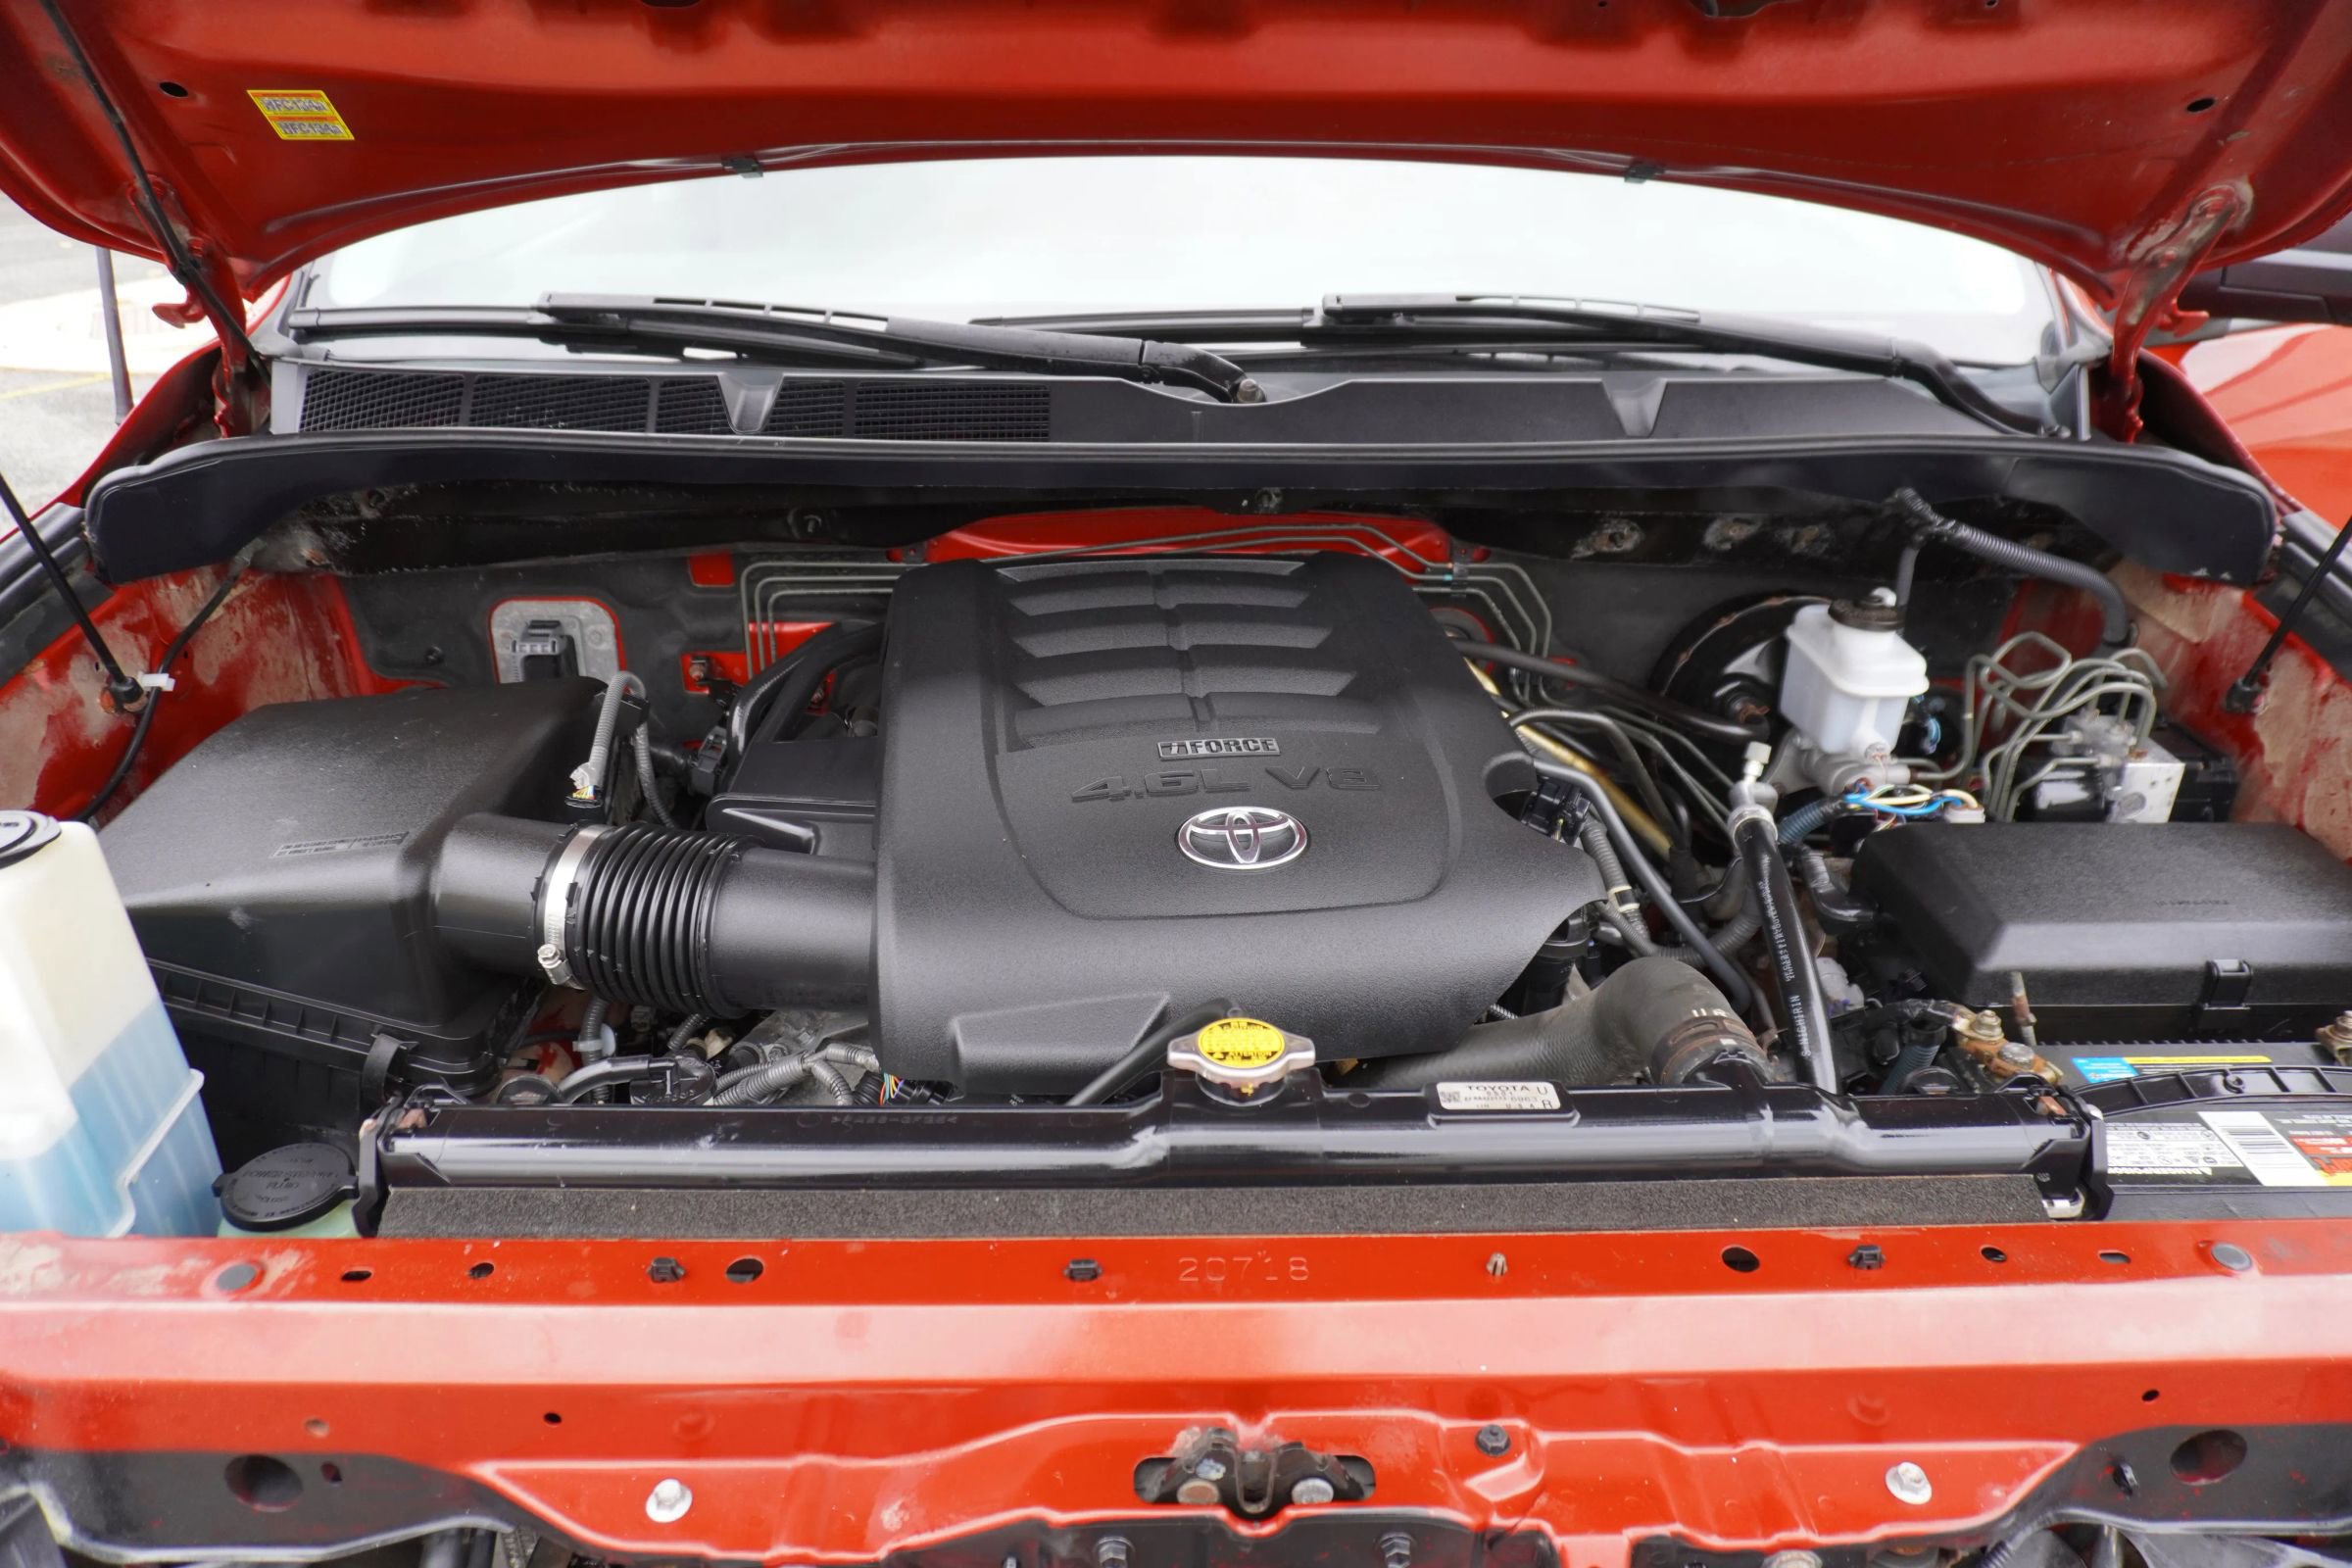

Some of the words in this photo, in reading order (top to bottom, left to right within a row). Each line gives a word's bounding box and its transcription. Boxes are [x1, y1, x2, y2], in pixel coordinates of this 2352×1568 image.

[1071, 767, 1251, 803] 4.6L
[1264, 765, 1381, 791] V8
[1178, 1256, 1310, 1282] 20718
